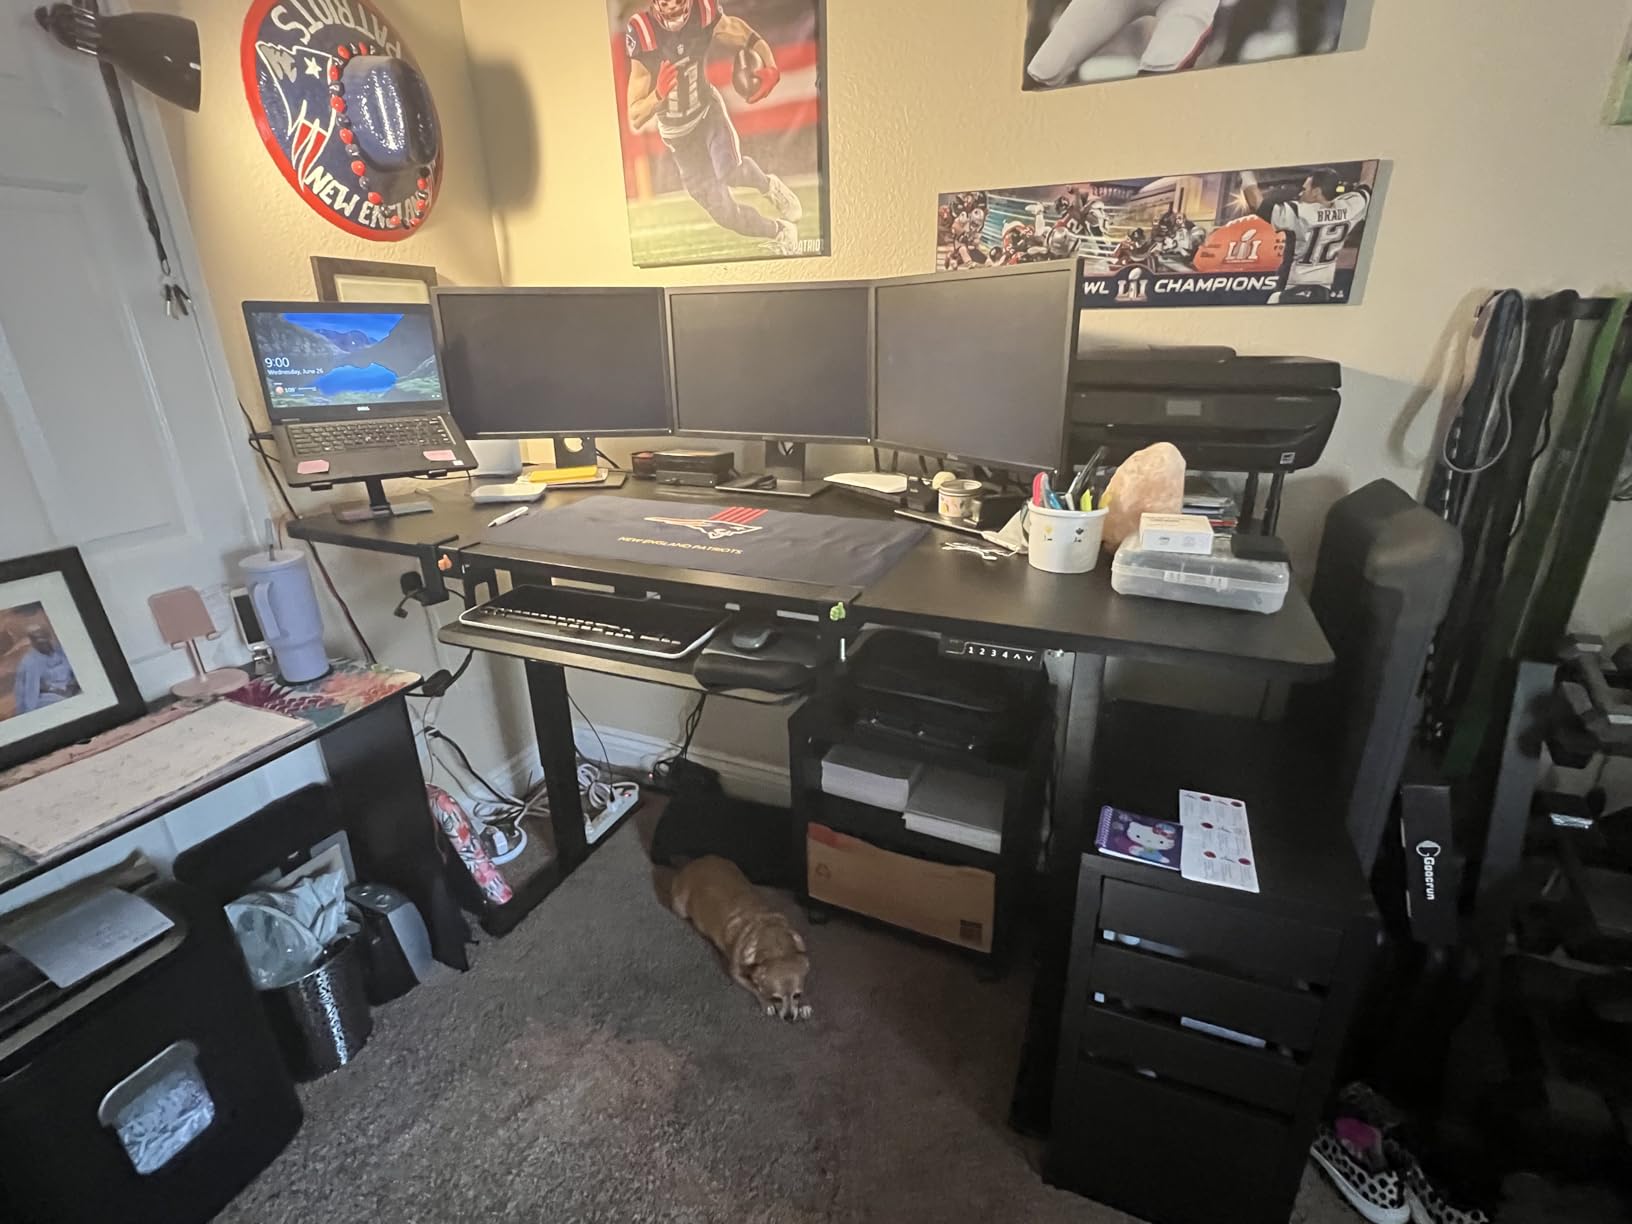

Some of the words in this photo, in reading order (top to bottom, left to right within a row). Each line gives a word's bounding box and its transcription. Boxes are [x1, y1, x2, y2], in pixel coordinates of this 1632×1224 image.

[666, 56, 701, 118] 11
[304, 165, 360, 217] NEW
[1317, 208, 1348, 223] BRADY
[792, 239, 821, 253] PATRIO
[1298, 222, 1351, 265] 12
[1083, 280, 1110, 295] WL
[1154, 275, 1280, 293] CHAMPIONS
[264, 357, 290, 368] 9:00
[641, 539, 692, 549] ENGLAND
[691, 544, 744, 555] PATRIOTS
[968, 646, 974, 654] 1
[979, 648, 986, 656] 2
[991, 649, 997, 657] 3
[1002, 651, 1009, 659] 4
